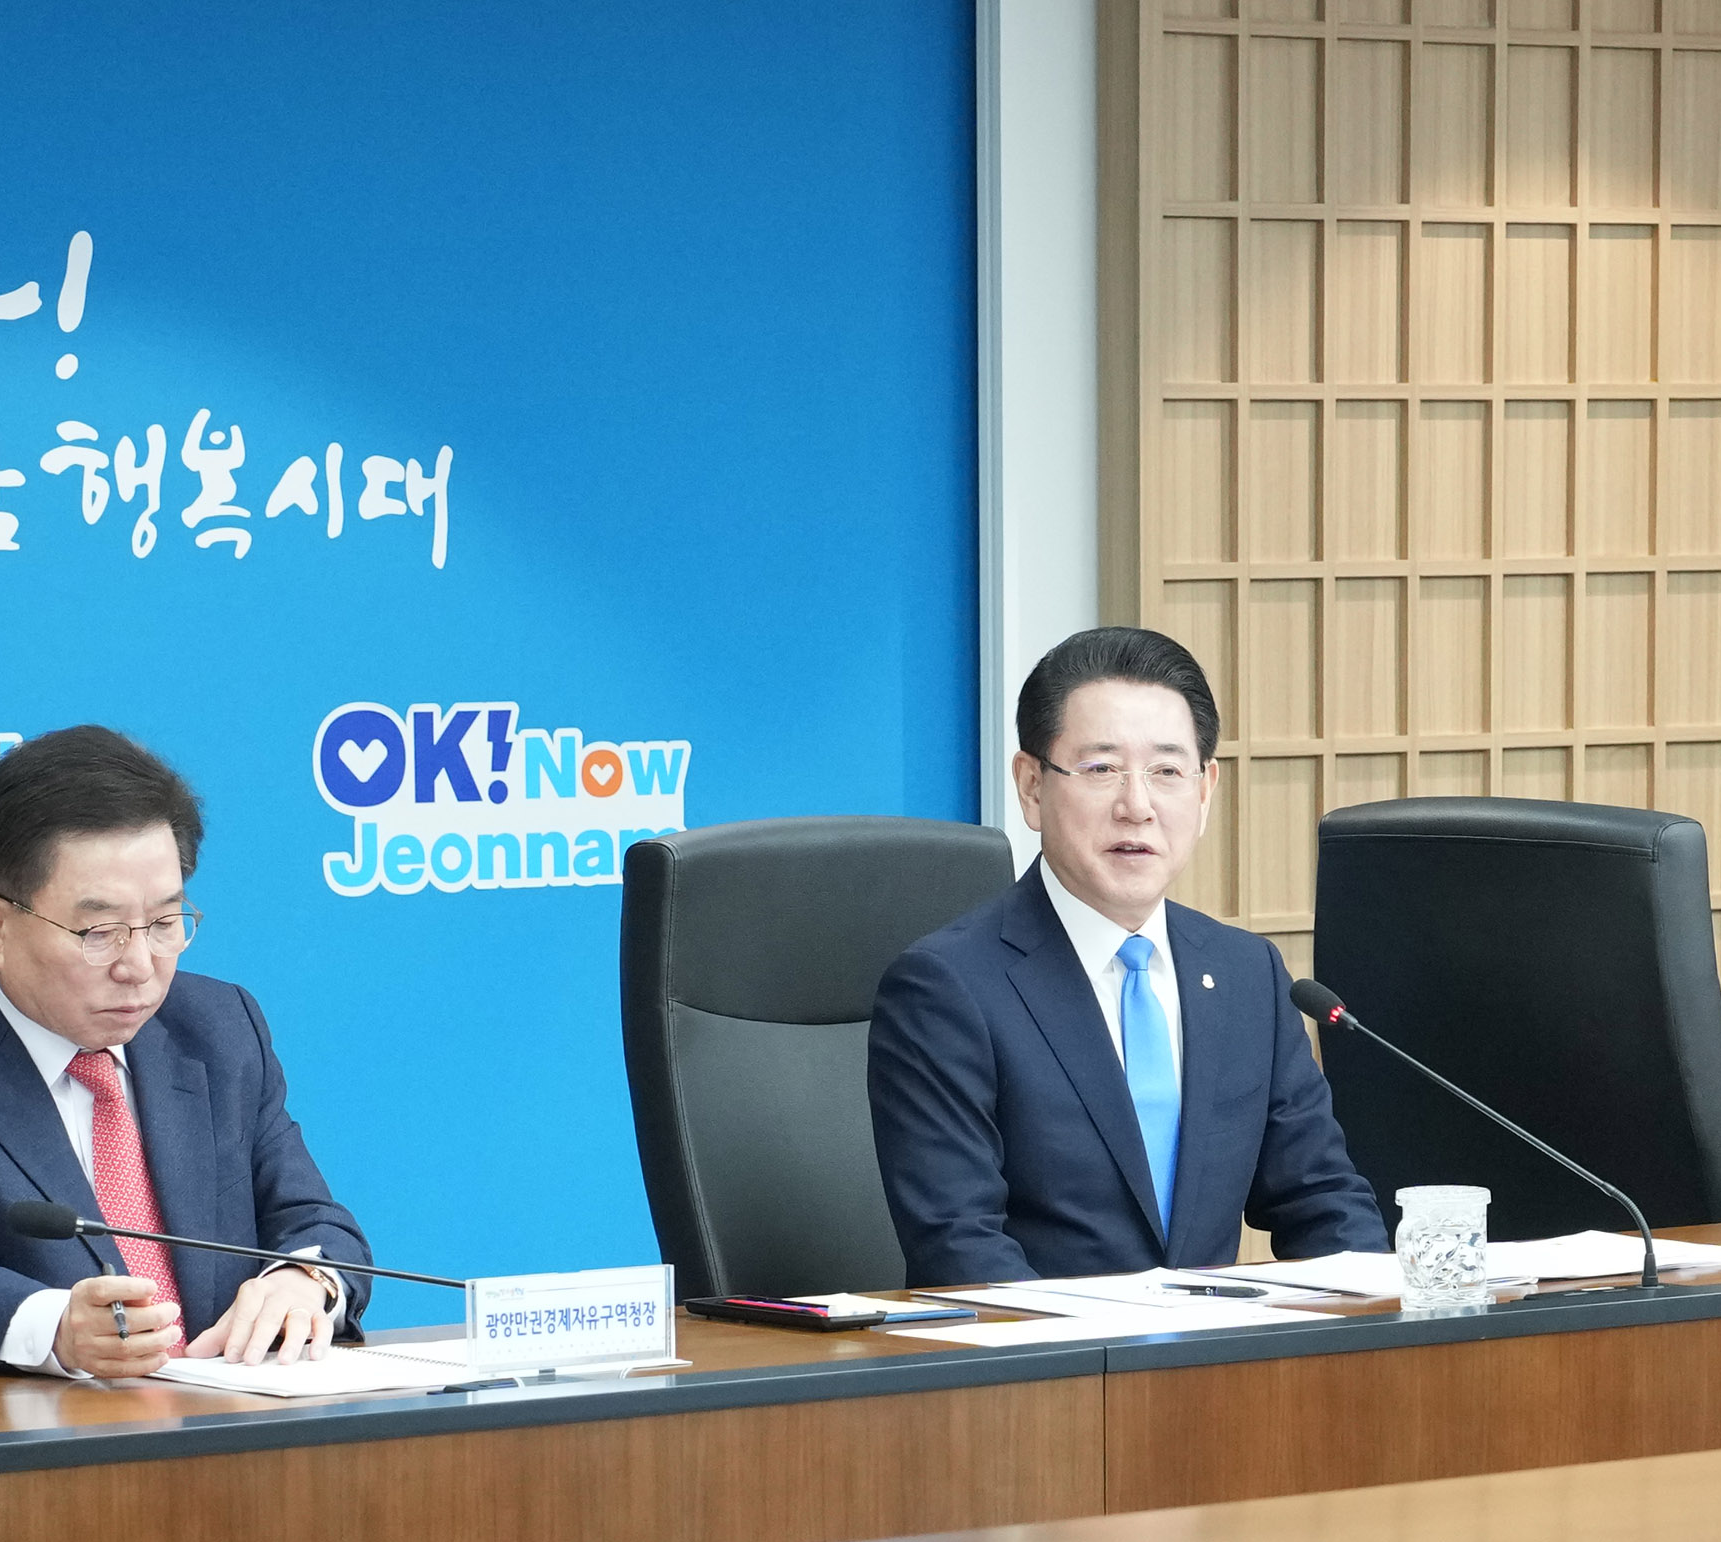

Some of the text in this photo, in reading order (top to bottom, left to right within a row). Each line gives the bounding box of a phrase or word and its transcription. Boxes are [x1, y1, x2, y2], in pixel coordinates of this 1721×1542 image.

[320, 709, 684, 807] OK! Now
[330, 822, 680, 887] Jeonna
[485, 1300, 656, 1339] 광양만권경제자유구역청장
